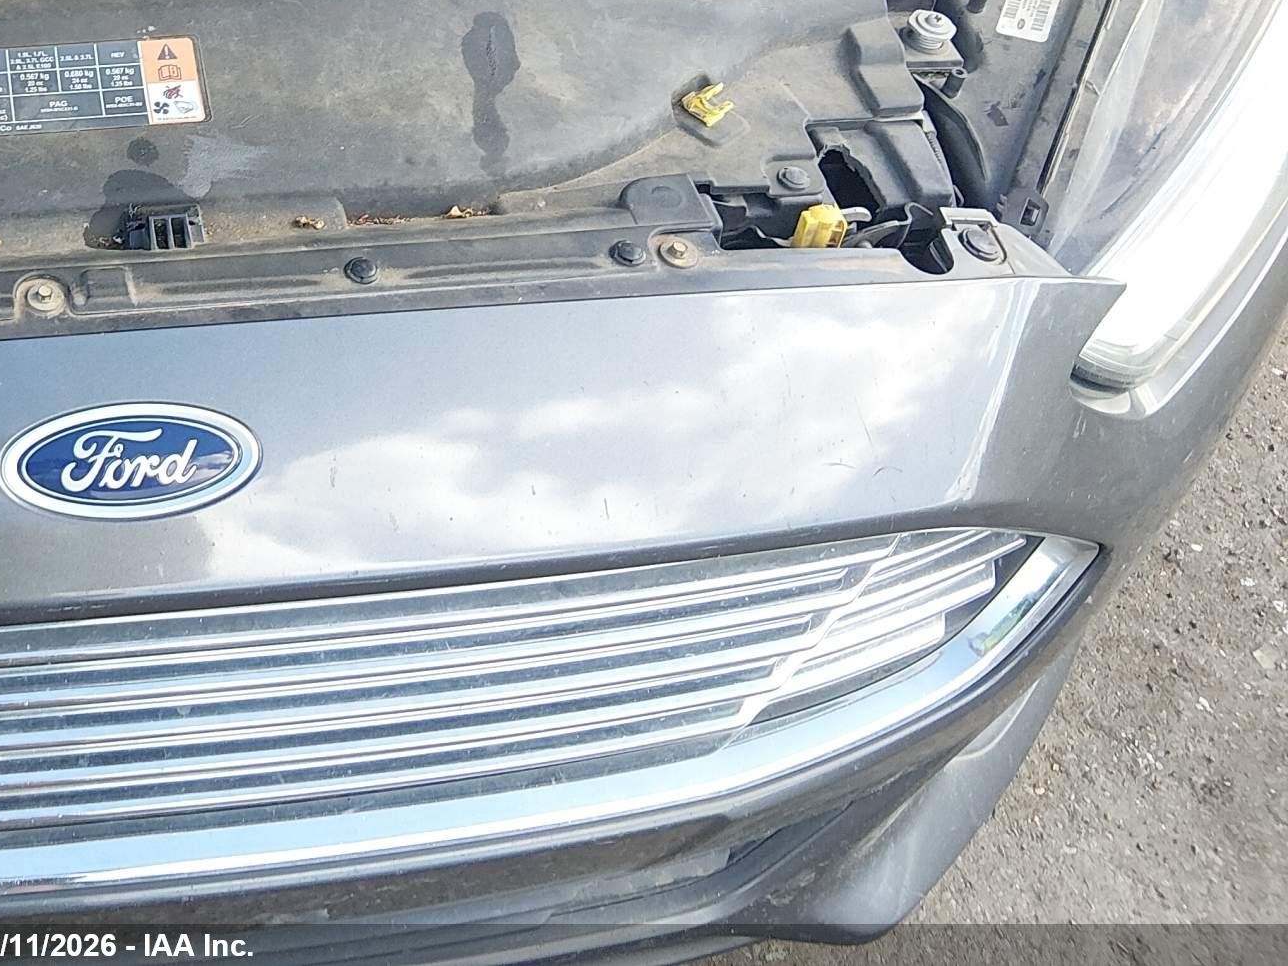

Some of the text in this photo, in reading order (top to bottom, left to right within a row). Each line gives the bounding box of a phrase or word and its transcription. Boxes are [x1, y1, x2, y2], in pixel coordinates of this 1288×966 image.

[84, 70, 94, 78] kg
[124, 68, 134, 76] kg
[39, 73, 50, 81] kg
[49, 100, 68, 108] PAG
[60, 427, 198, 492] Ford
